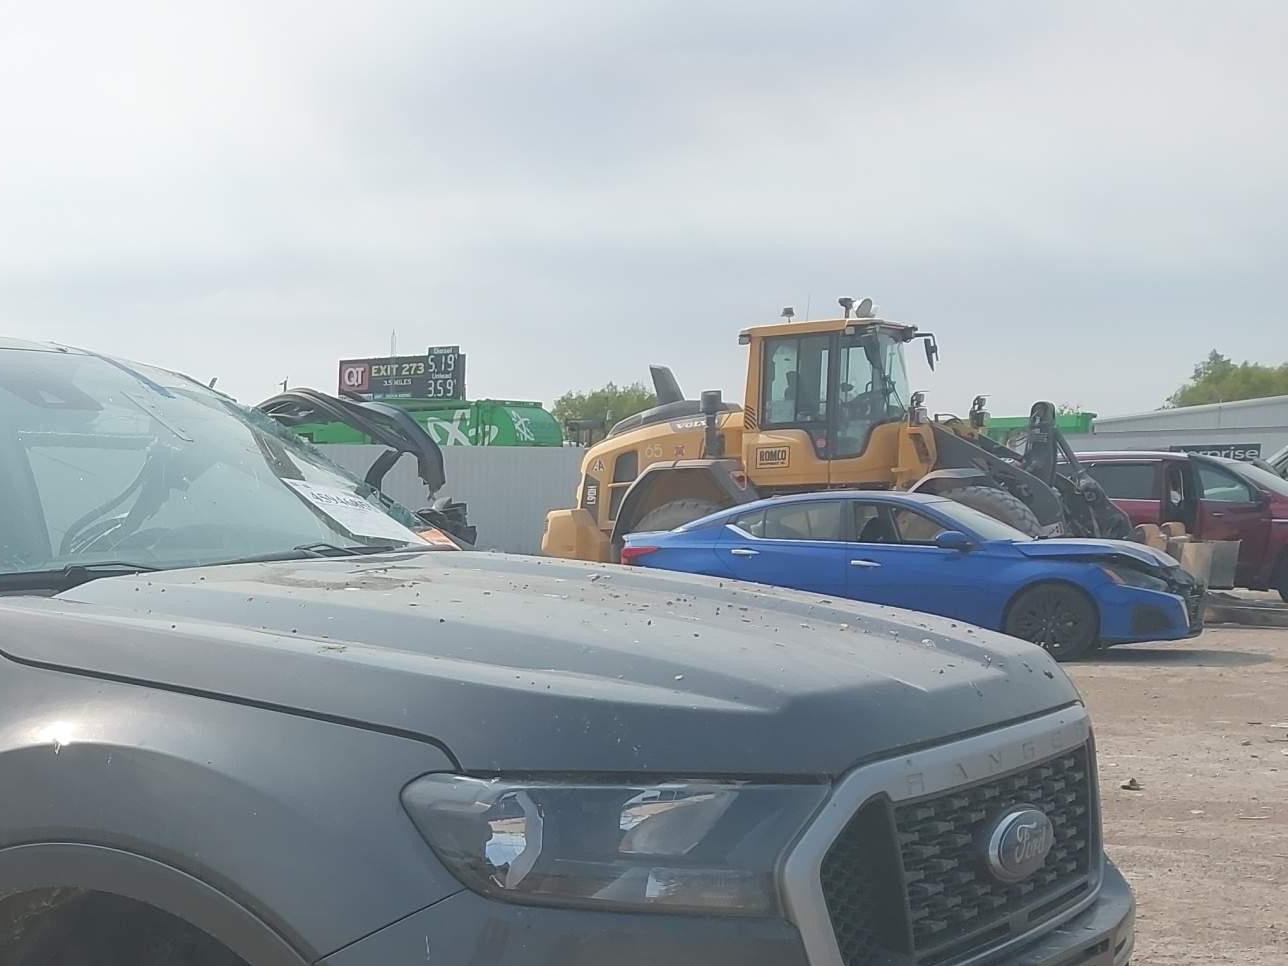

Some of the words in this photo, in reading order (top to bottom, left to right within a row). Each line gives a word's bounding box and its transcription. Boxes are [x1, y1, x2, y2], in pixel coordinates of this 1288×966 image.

[344, 367, 365, 386] QT
[371, 363, 399, 377] EXIT
[401, 362, 425, 375] 273
[645, 443, 663, 458] 65
[759, 449, 787, 462] ROMCO
[1015, 821, 1048, 864] Ford
